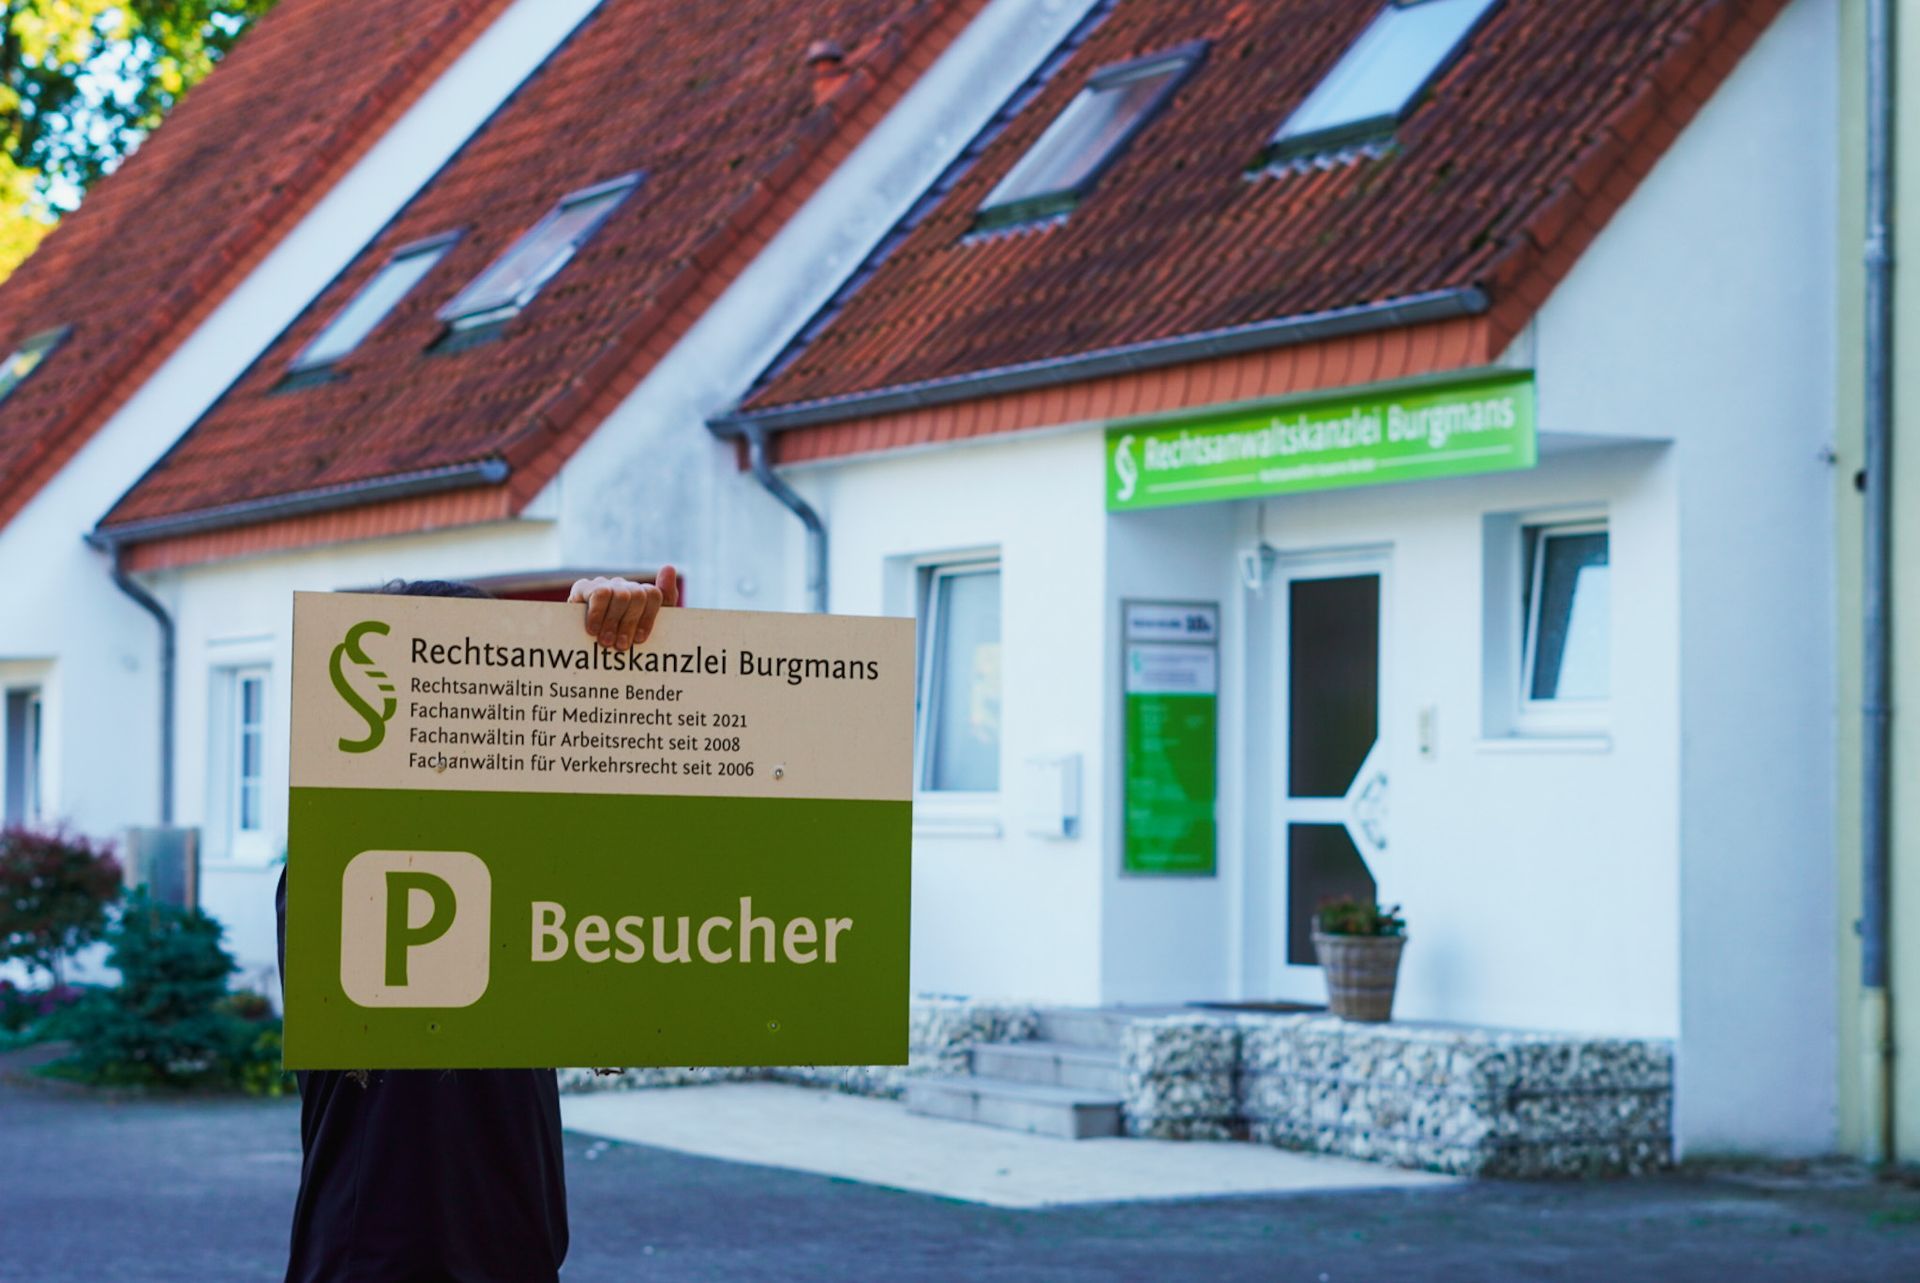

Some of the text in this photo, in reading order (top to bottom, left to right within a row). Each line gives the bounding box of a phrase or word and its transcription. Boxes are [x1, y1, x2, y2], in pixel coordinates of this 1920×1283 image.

[1144, 407, 1382, 471] Rechtsanwaltskanzlei
[1387, 397, 1516, 448] Burgmans
[411, 636, 879, 686] Rechtsanwaltskanzlei Burgmans
[410, 677, 683, 702] Rechtsanwältin Susanne Bender
[410, 702, 747, 728] Fachanwältin für Medizinrecht seit 2021
[409, 727, 741, 753] Fachanwältin für Arbeitsrecht seit 2008
[409, 752, 754, 777] Fachanwältin für Verkehrsrecht seit 2006
[385, 871, 853, 986] P Besucher
